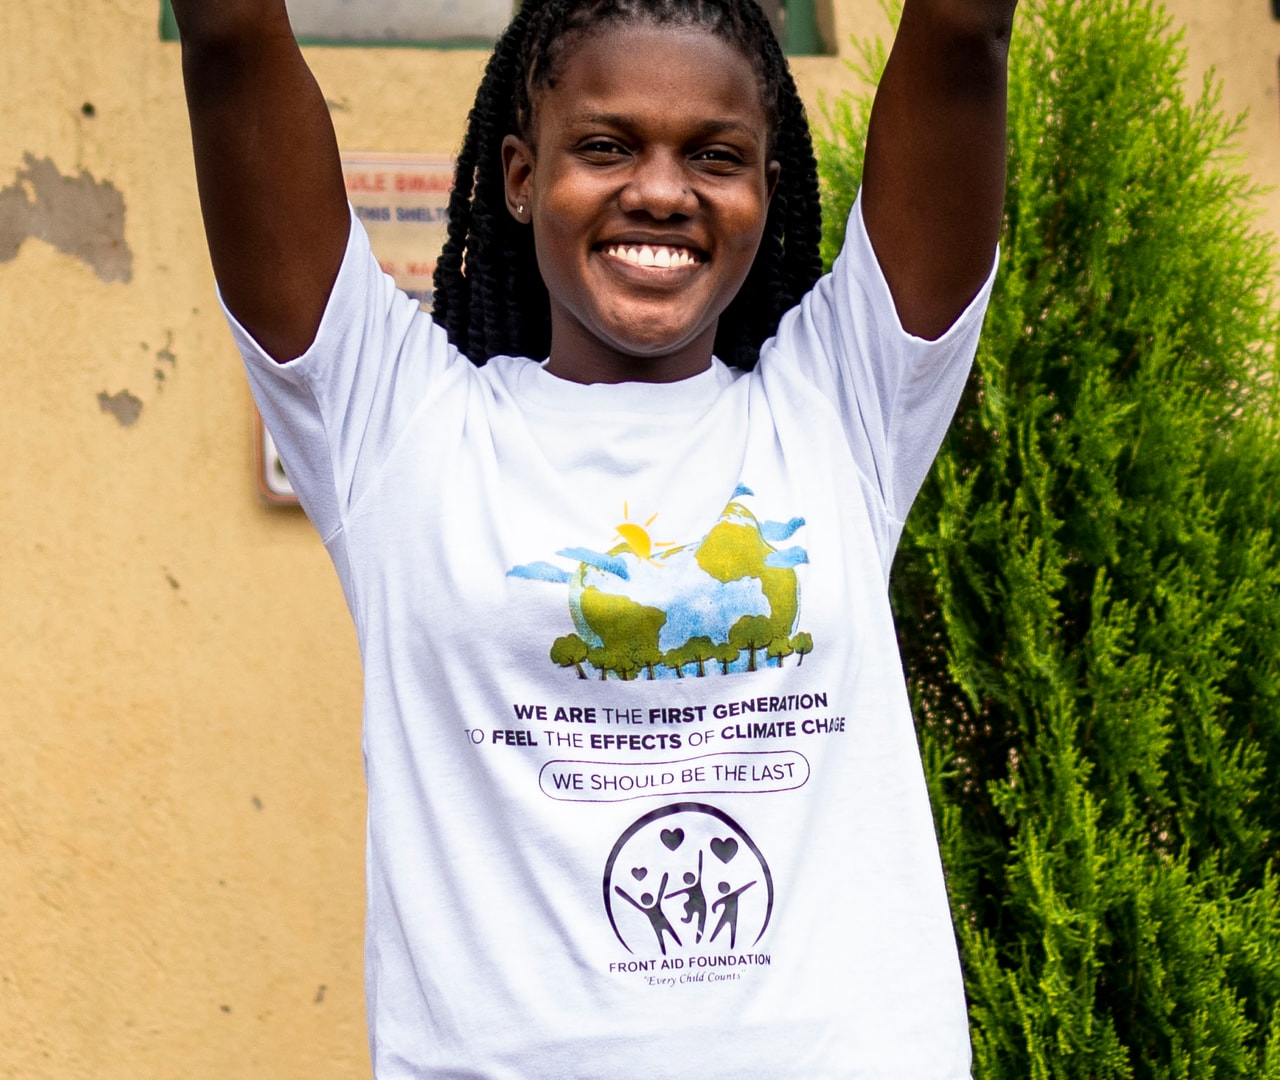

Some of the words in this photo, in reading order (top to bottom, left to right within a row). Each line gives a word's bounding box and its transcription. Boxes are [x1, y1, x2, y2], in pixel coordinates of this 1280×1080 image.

[395, 206, 452, 222] SHELT
[513, 704, 547, 720] WE
[553, 707, 596, 723] ARE
[602, 708, 643, 724] THE
[649, 706, 707, 724] FIRST
[712, 692, 828, 719] GENERATION
[492, 730, 538, 746] FEEL
[544, 731, 583, 748] THE
[590, 734, 682, 750] EFFECTS
[688, 730, 715, 746] OF
[721, 721, 796, 740] CLIMATE
[552, 773, 584, 790] WE
[590, 772, 675, 790] SHOULD
[681, 766, 705, 783] BE
[712, 765, 747, 781] THE
[752, 762, 795, 781] LAST
[609, 960, 656, 973] FRONT
[661, 958, 684, 970] AID
[688, 954, 771, 968] FOUNDATION
[679, 971, 704, 984] Child
